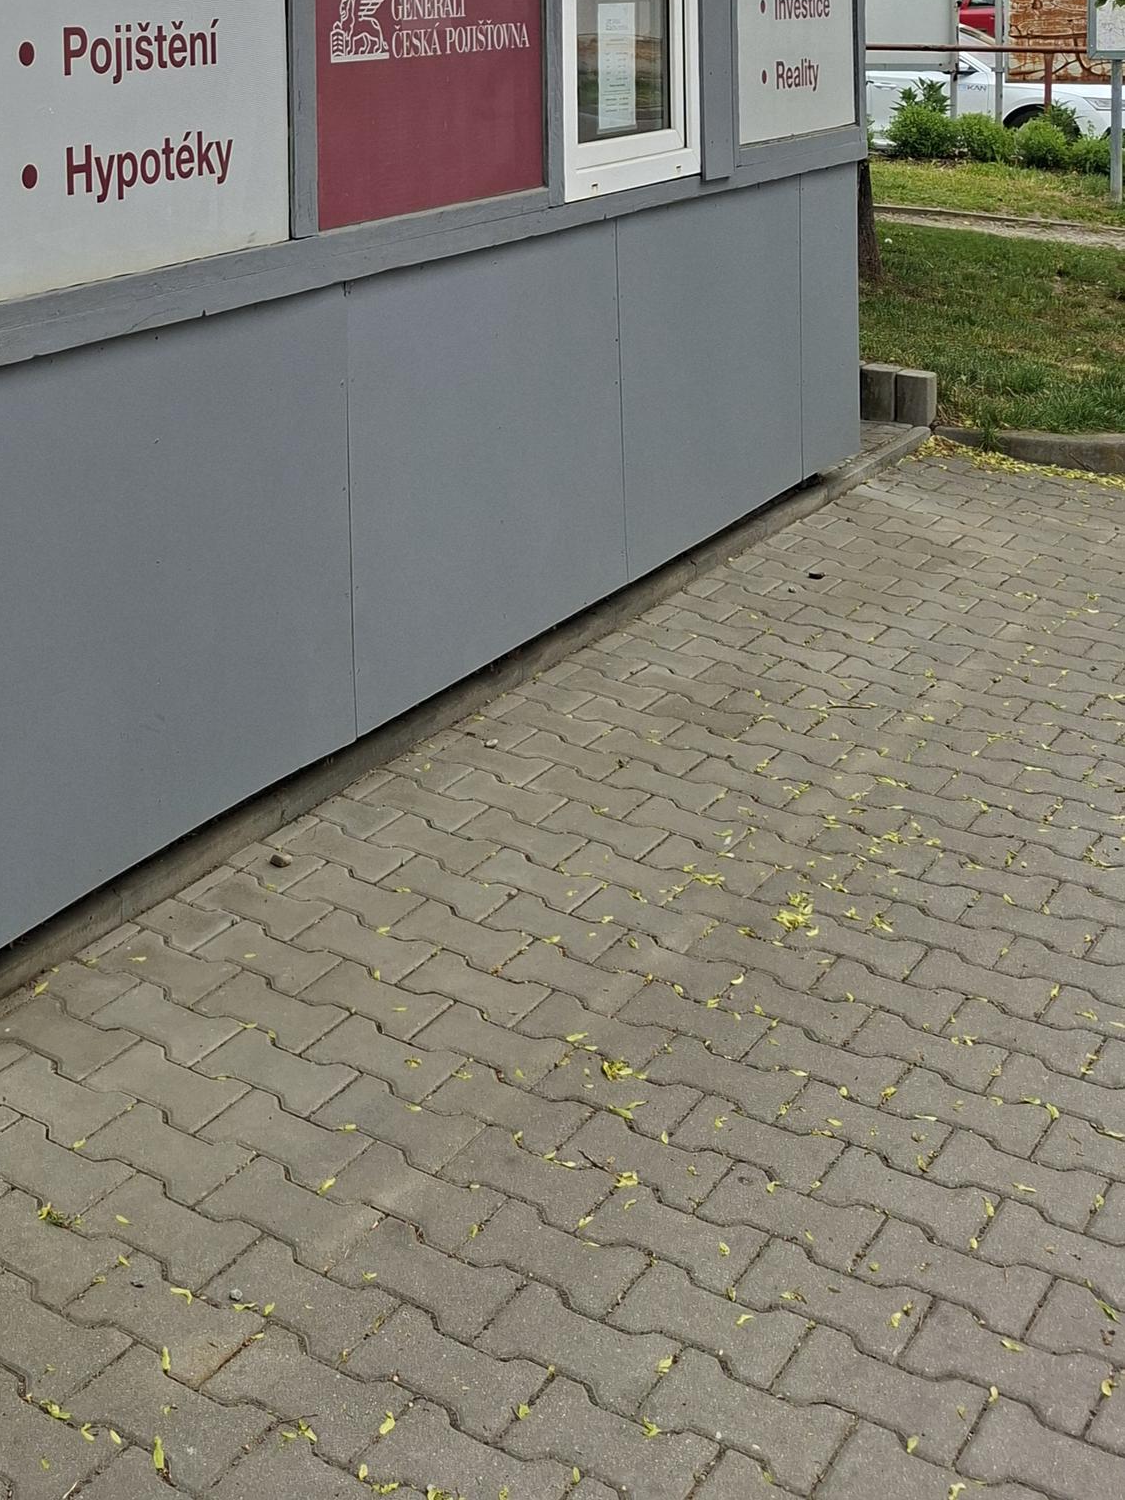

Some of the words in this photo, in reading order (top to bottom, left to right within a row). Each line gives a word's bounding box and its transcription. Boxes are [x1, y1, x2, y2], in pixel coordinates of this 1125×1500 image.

[62, 18, 220, 85] Pojištění
[391, 21, 442, 59] ČESKÁ
[445, 19, 531, 55] POJIŠŤOVNA
[775, 58, 820, 92] Reality
[64, 130, 234, 204] Hypotéky
